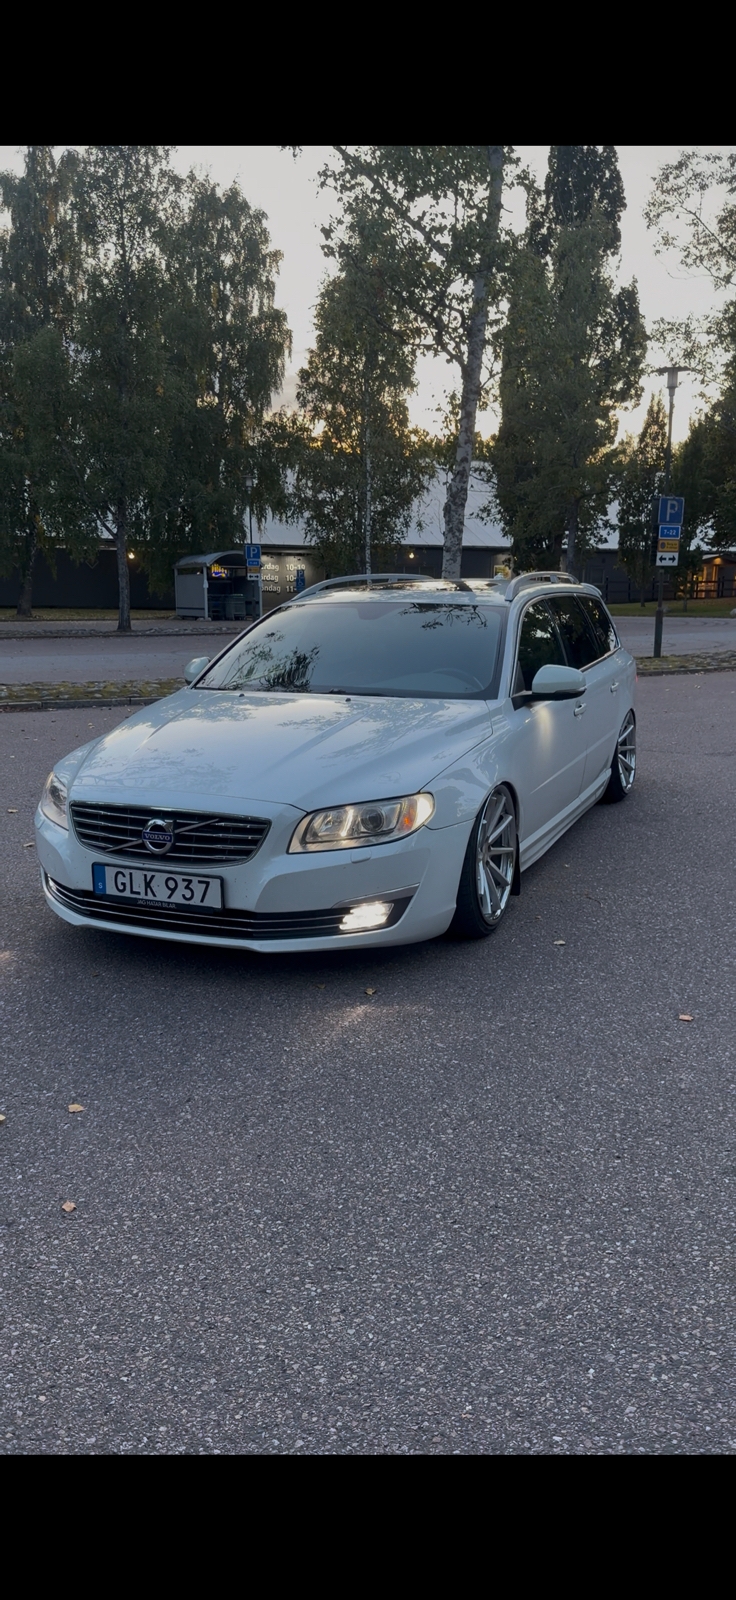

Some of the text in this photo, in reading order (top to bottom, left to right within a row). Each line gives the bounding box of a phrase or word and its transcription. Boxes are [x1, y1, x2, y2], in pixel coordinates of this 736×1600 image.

[666, 500, 678, 521] P
[250, 547, 257, 558] P
[114, 871, 210, 903] GLK 937
